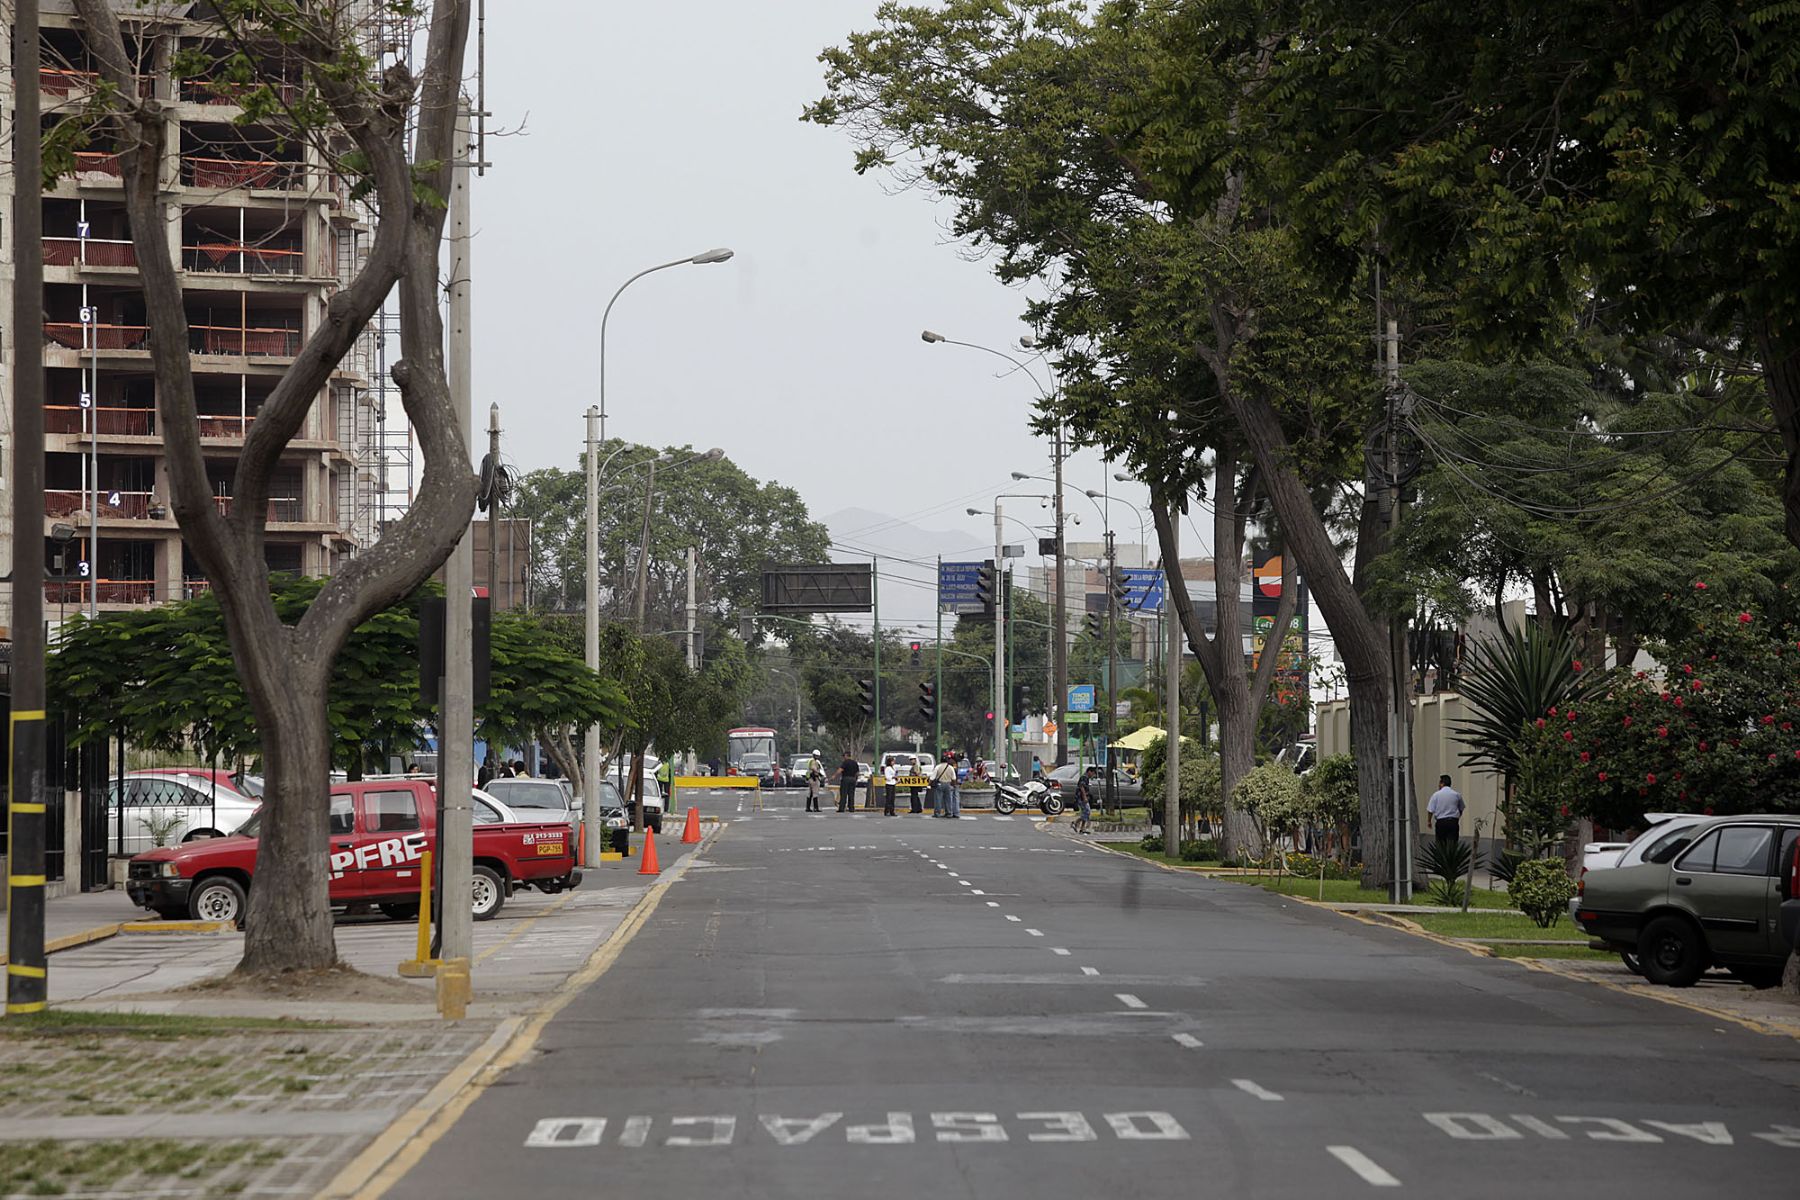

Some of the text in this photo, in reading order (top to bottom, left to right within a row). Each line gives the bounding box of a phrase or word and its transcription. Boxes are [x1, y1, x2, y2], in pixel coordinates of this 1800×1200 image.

[78, 223, 89, 237] 7
[80, 308, 91, 322] 6
[81, 394, 91, 407] 5
[110, 493, 120, 506] 4
[79, 563, 89, 576] 3
[328, 832, 428, 880] PFRE
